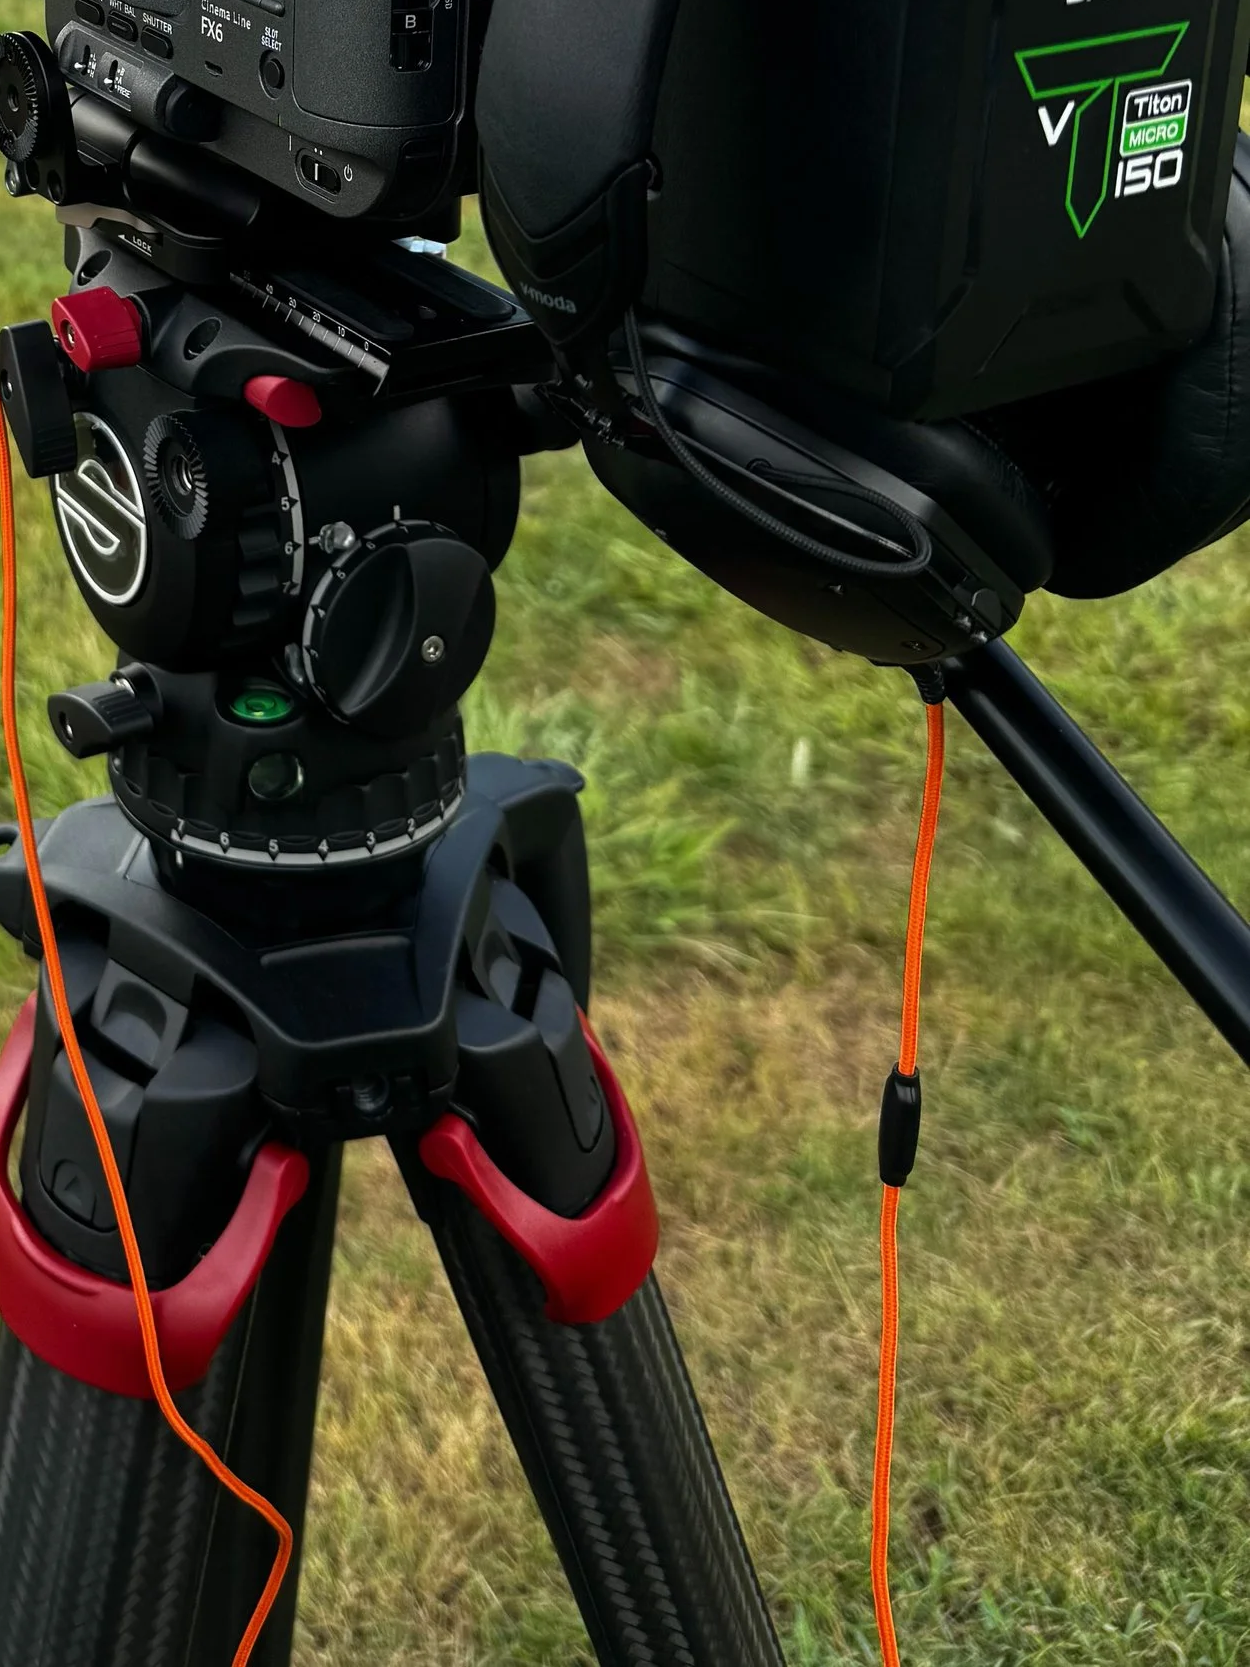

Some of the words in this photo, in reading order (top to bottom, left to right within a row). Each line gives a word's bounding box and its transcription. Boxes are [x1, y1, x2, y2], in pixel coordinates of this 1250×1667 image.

[124, 4, 137, 18] BAL
[142, 12, 173, 35] SHUTTER
[233, 10, 252, 30] Line
[405, 15, 417, 29] B
[201, 16, 224, 43] FX6
[265, 26, 279, 39] SLOT
[261, 34, 283, 52] SELECT
[1133, 91, 1183, 118] Titon
[1038, 99, 1076, 147] V
[1128, 121, 1179, 149] MICRO
[1114, 148, 1183, 199] 150
[132, 235, 152, 253] LOCK
[288, 296, 297, 309] 30
[519, 281, 577, 314] v-moda
[312, 311, 321, 323] 20
[337, 326, 346, 338] 10
[364, 341, 369, 352] 0
[271, 450, 282, 464] 4
[281, 496, 290, 511] 5
[284, 541, 294, 555] 6
[176, 818, 184, 831] 7
[405, 817, 416, 831] 2
[219, 831, 229, 846] 6
[268, 838, 279, 853] 5
[317, 839, 329, 853] 4
[366, 831, 376, 846] 3
